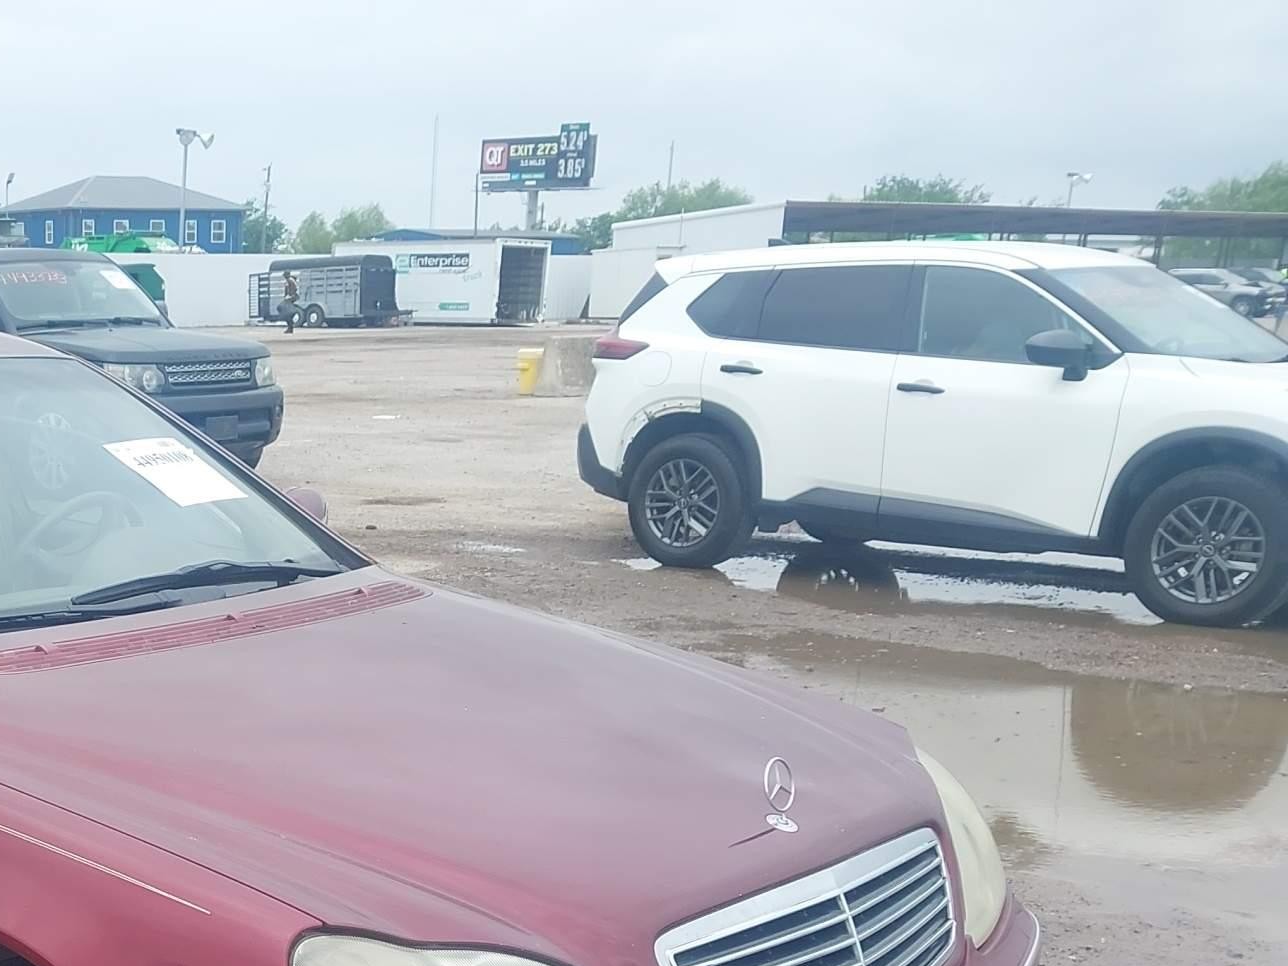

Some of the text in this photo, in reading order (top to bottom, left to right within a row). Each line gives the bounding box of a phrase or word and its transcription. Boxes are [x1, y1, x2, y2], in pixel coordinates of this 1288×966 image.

[486, 146, 504, 167] QT
[509, 142, 558, 157] EXIT 273
[410, 255, 469, 268] Enterprise
